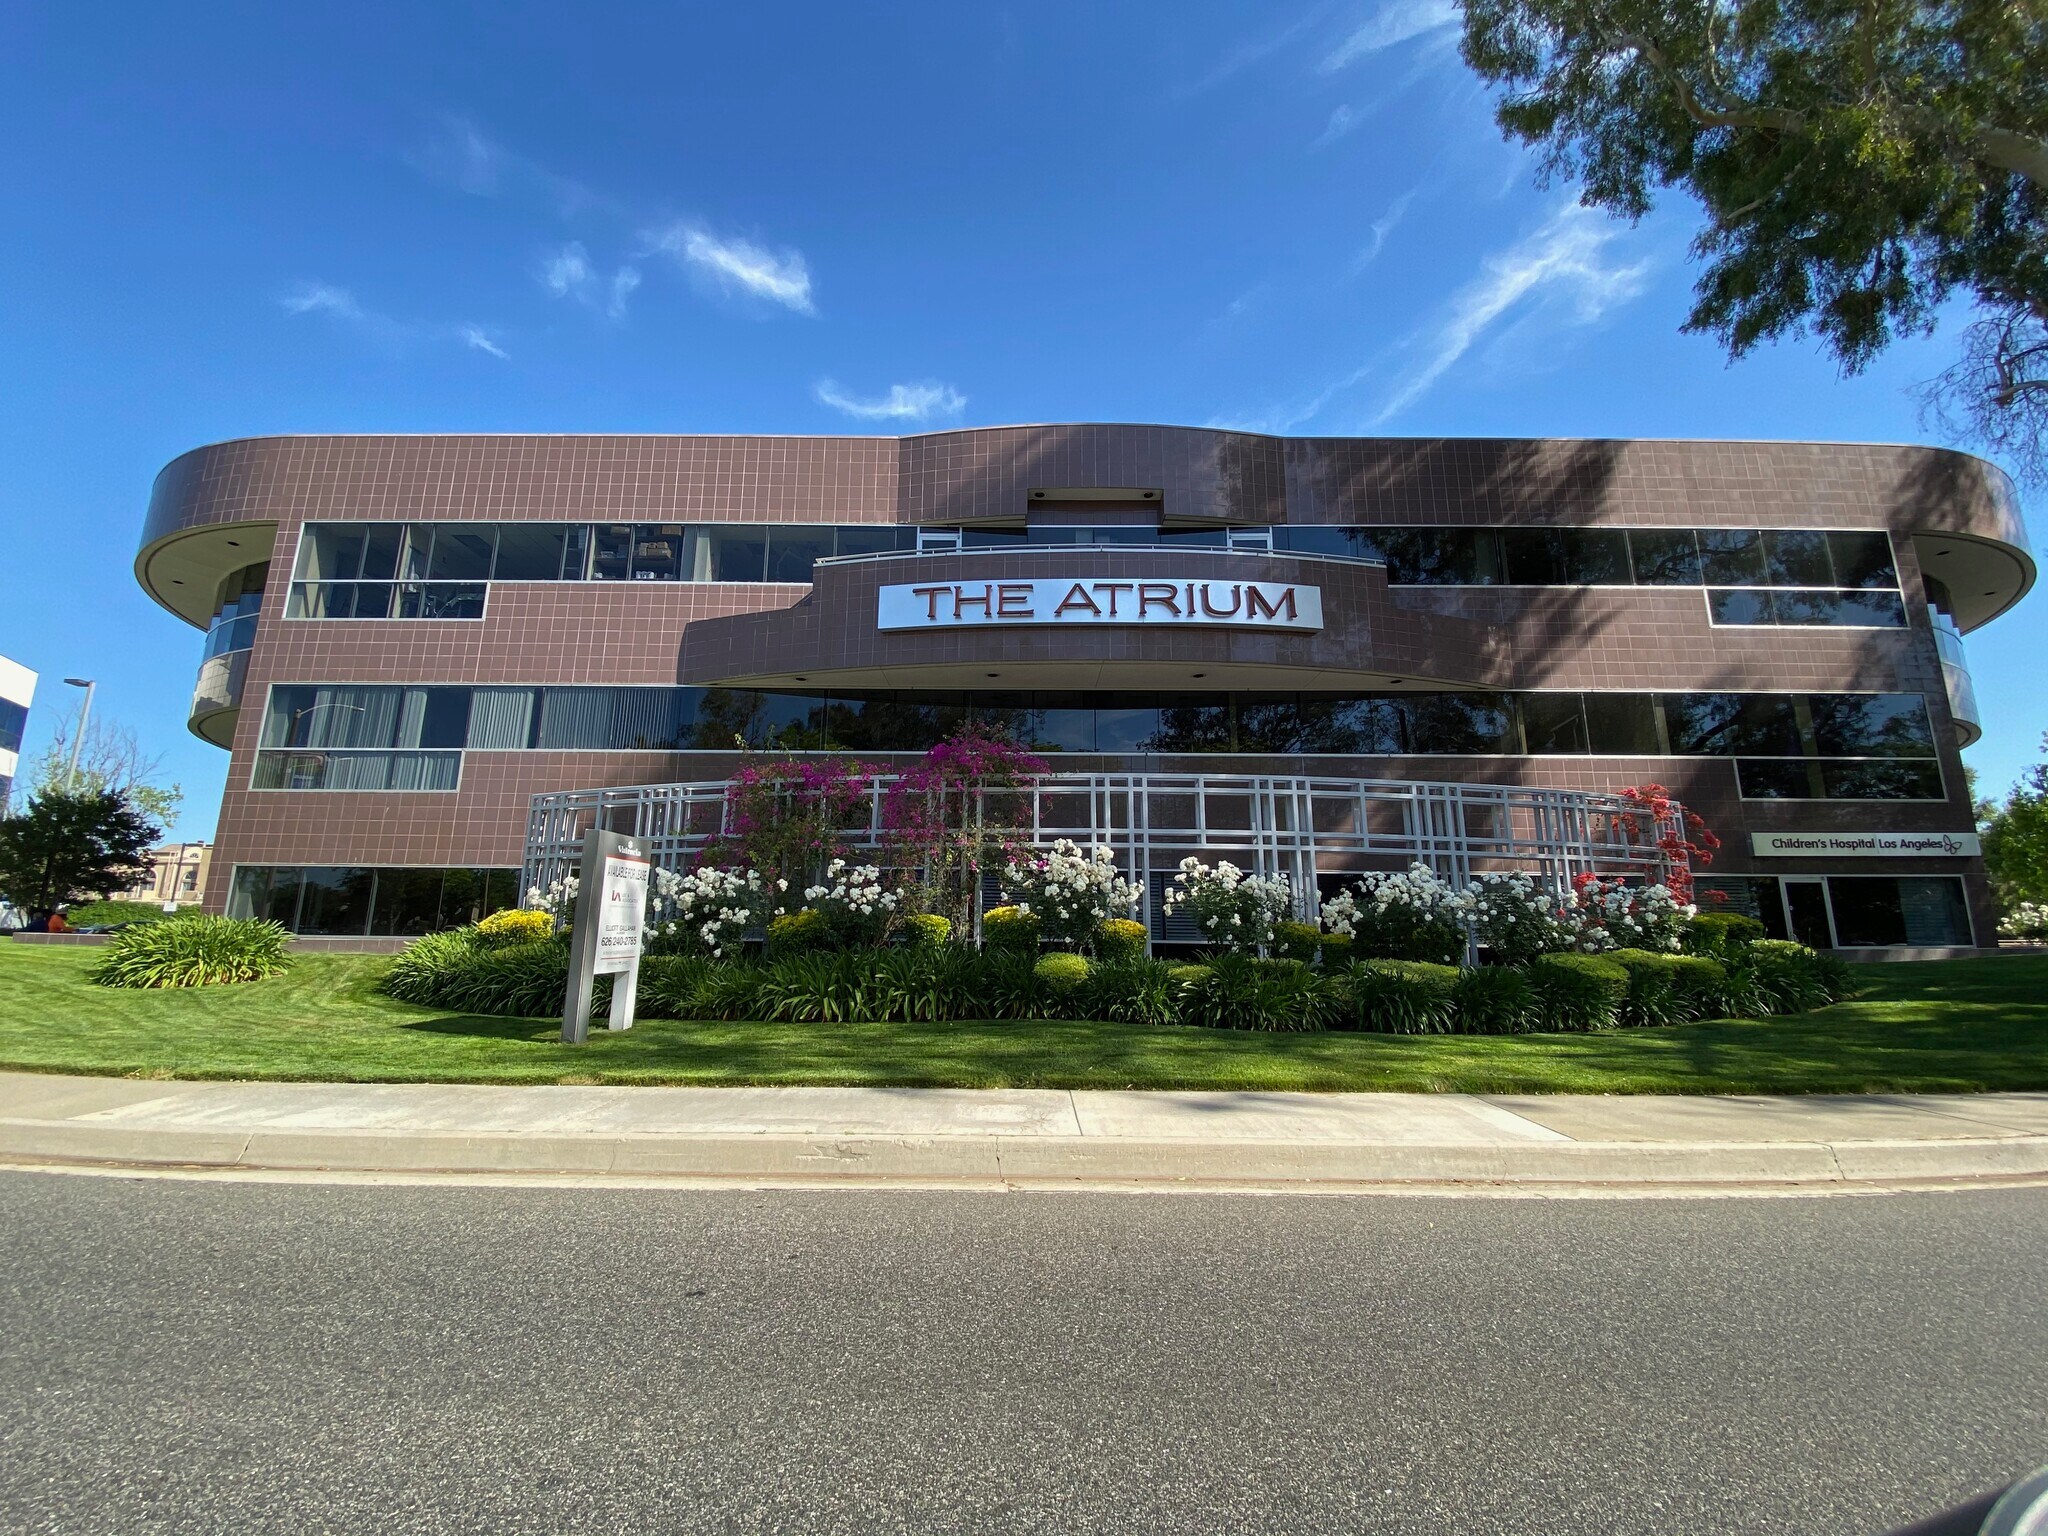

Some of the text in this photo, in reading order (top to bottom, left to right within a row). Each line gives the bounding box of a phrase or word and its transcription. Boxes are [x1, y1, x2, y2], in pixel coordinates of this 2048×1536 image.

[912, 582, 1299, 621] THE ATRIUM
[1771, 838, 1944, 851] Children's Hospital Los Angeles
